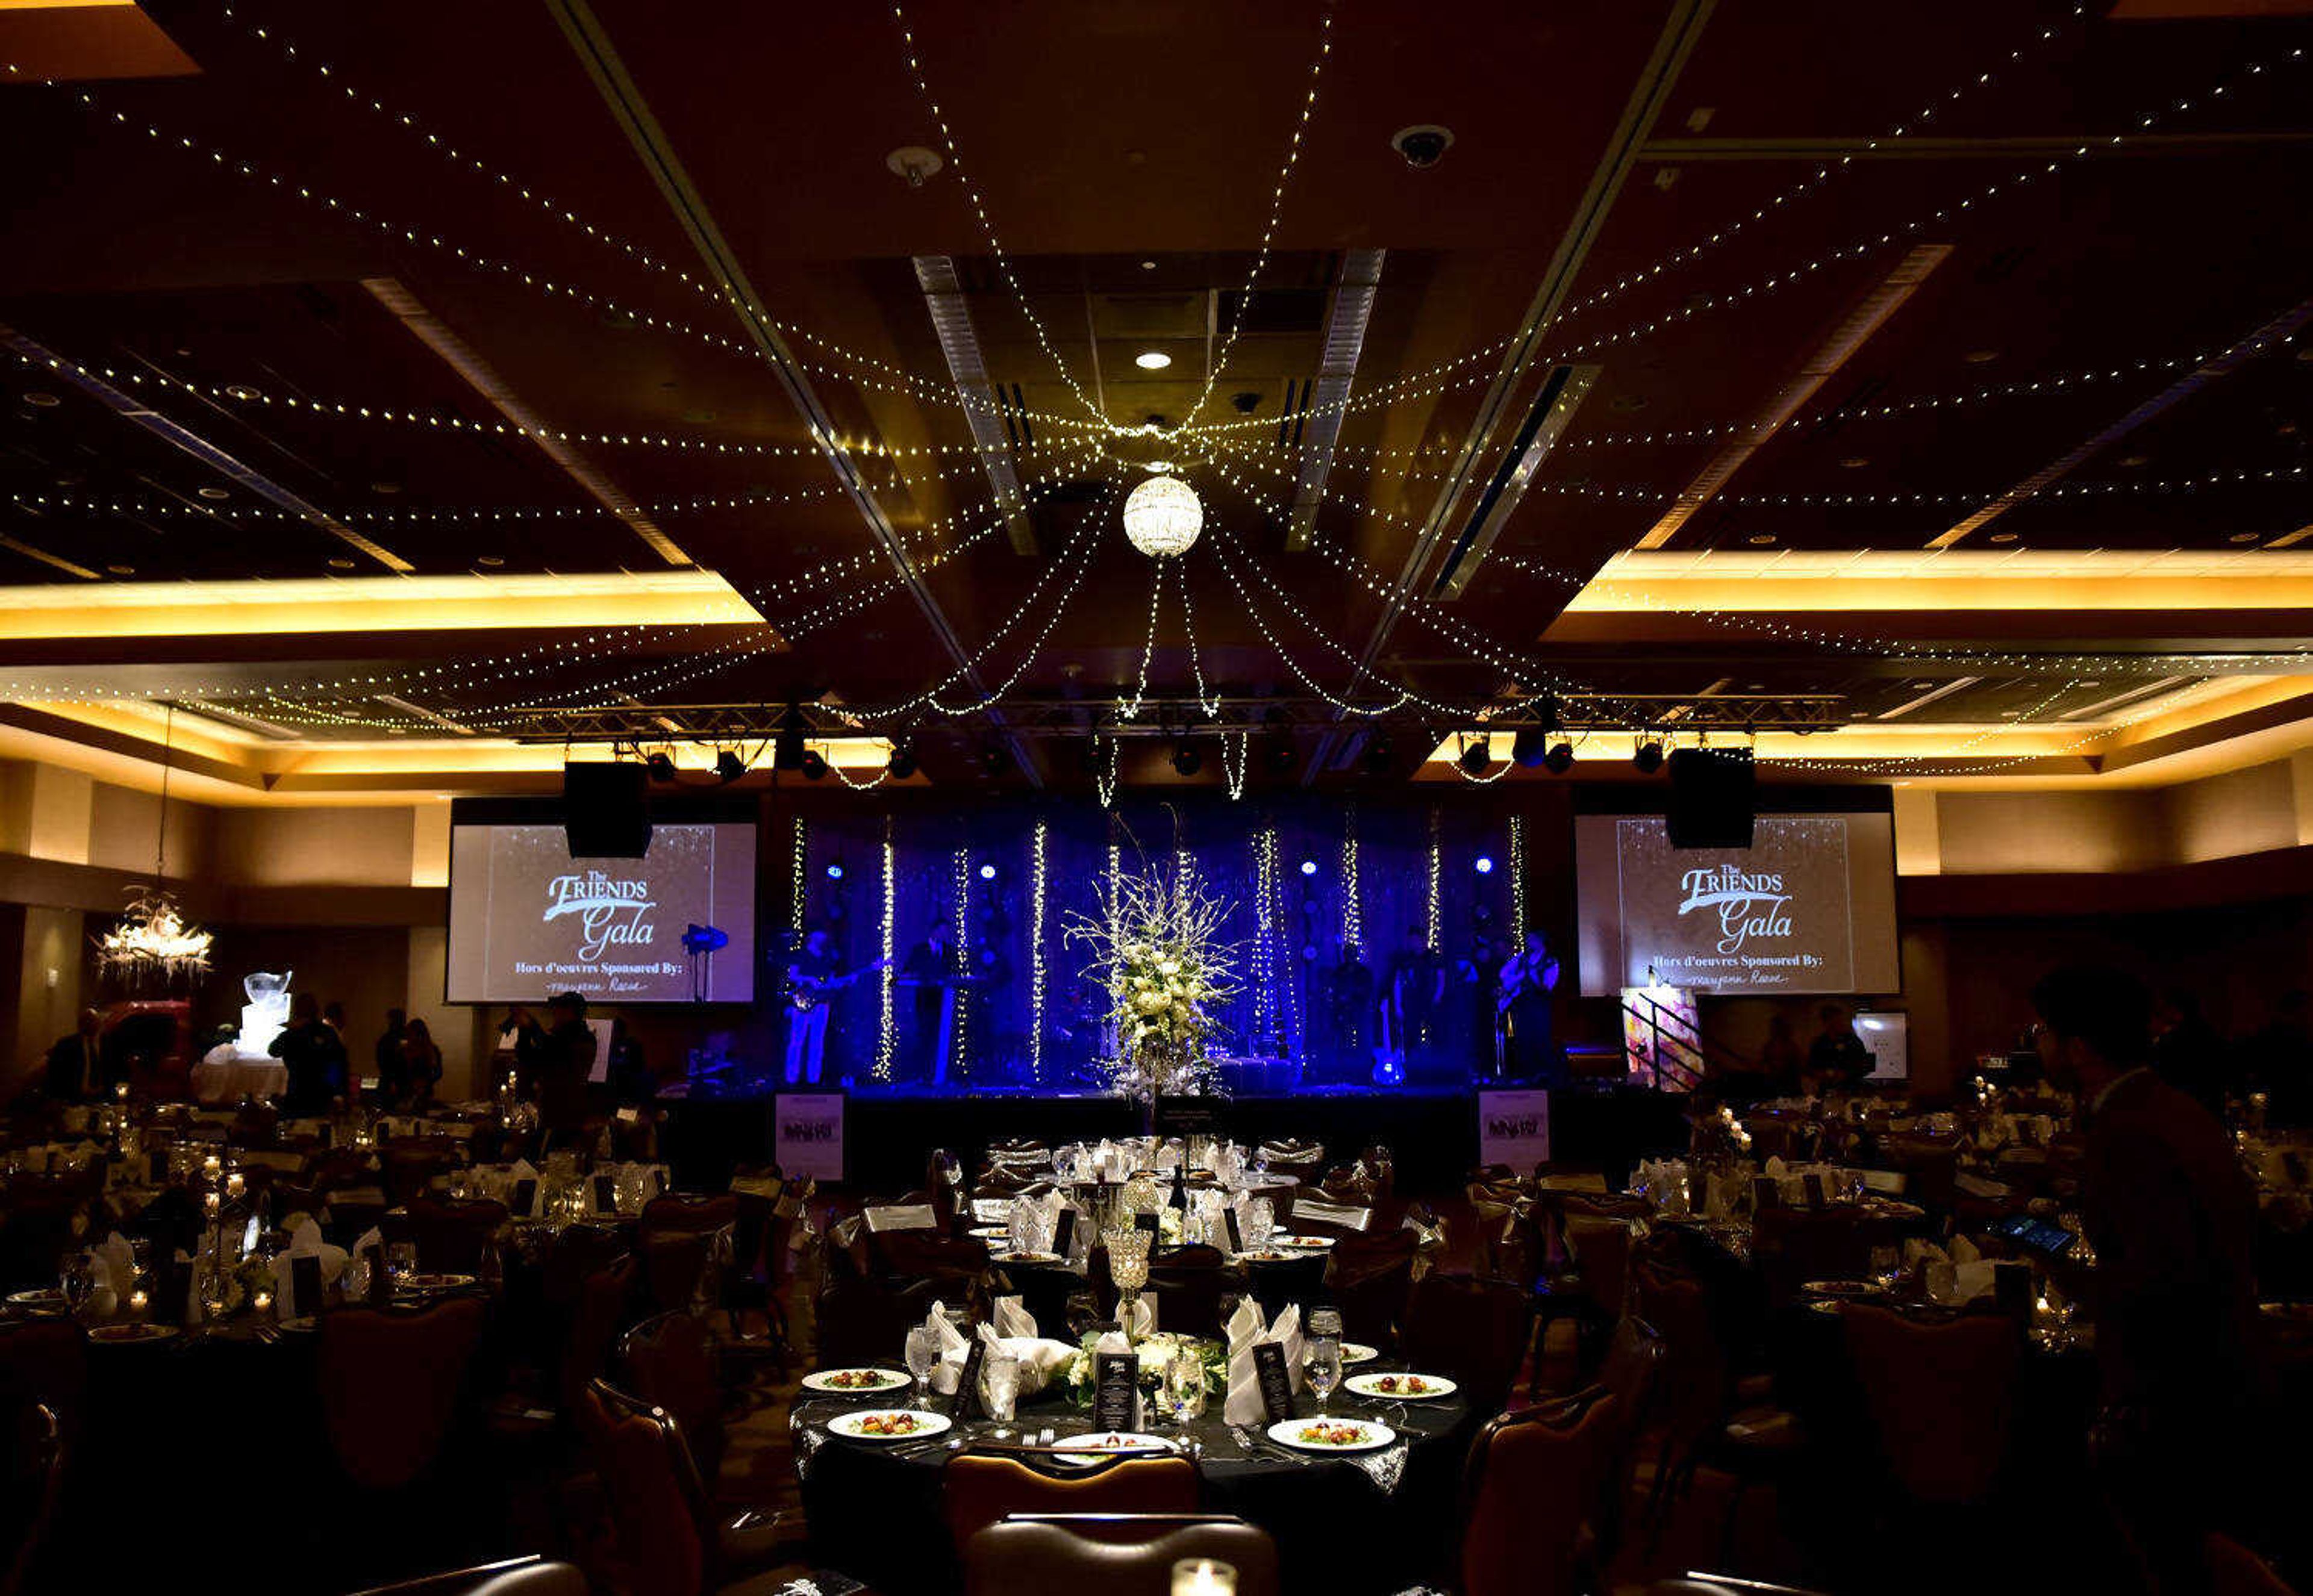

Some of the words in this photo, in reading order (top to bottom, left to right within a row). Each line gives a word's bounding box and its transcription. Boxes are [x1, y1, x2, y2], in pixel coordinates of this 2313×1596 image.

[587, 870, 607, 882] The
[1720, 864, 1740, 875] The
[548, 876, 648, 905] FRIENDS
[1682, 868, 1783, 897] FRIENDS
[578, 903, 654, 961] Gala
[1717, 897, 1793, 954] Gala
[515, 962, 543, 974] Hors
[545, 962, 599, 974] d'oeuvres
[601, 962, 660, 976] Sponsored
[661, 962, 683, 976] By:
[1653, 955, 1681, 967] Hors
[1684, 955, 1738, 967] d'oeuvres
[1741, 954, 1800, 969] Sponsored
[1802, 953, 1823, 968] By:
